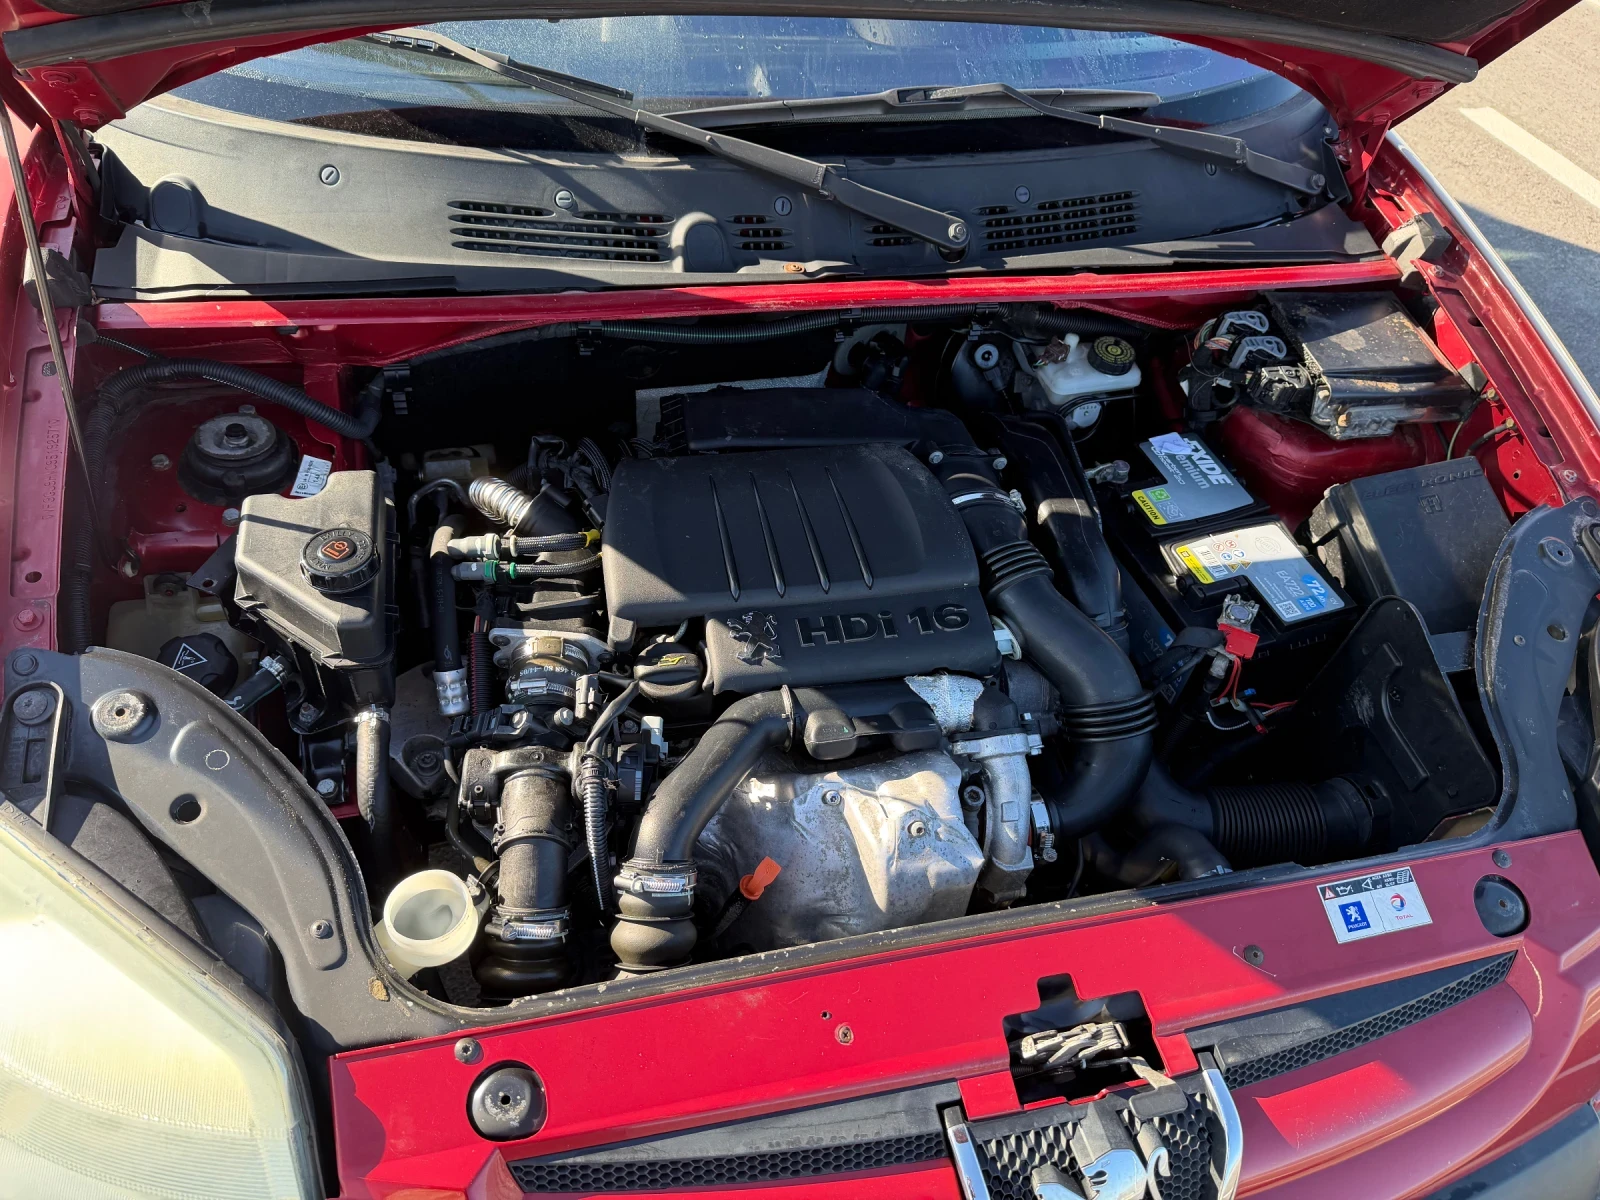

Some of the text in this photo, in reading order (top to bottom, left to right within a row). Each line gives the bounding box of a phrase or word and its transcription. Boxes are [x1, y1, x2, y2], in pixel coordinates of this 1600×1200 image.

[1175, 453, 1210, 490] emium
[1183, 437, 1232, 485] EXIDE
[1137, 495, 1160, 520] CAUTION
[1276, 570, 1305, 597] EA722
[1307, 580, 1325, 595] 72
[794, 603, 971, 648] HDi 16
[1142, 629, 1164, 658] EA72
